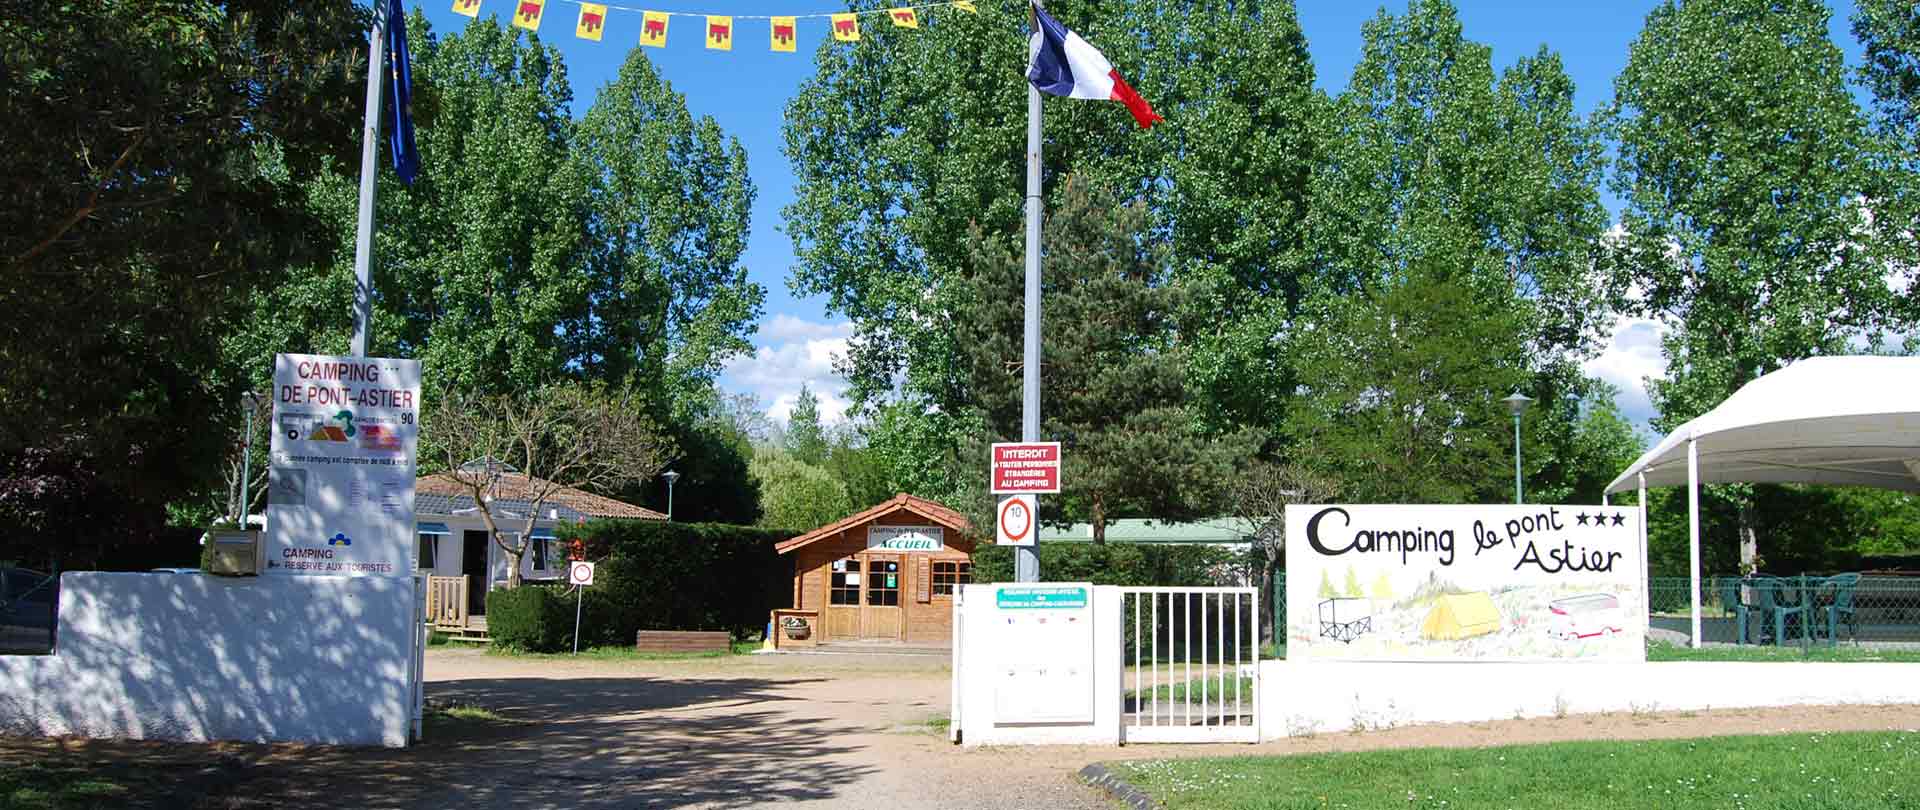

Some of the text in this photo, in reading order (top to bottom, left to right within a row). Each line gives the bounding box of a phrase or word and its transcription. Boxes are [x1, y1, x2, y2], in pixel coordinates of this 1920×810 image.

[298, 361, 379, 383] CAMPING
[282, 384, 413, 409] DE PONT-ASTIER
[401, 412, 414, 425] 90
[1002, 448, 1049, 459] INTERDIT
[1001, 479, 1049, 487] AU CAMPING
[1010, 506, 1022, 518] 10
[1306, 507, 1564, 566] Camping le pont
[880, 539, 932, 549] ACCUEIL
[282, 547, 334, 559] CAMPING
[1514, 540, 1623, 574] Astier
[326, 561, 343, 571] AUX
[344, 562, 393, 573] TOURISTES
